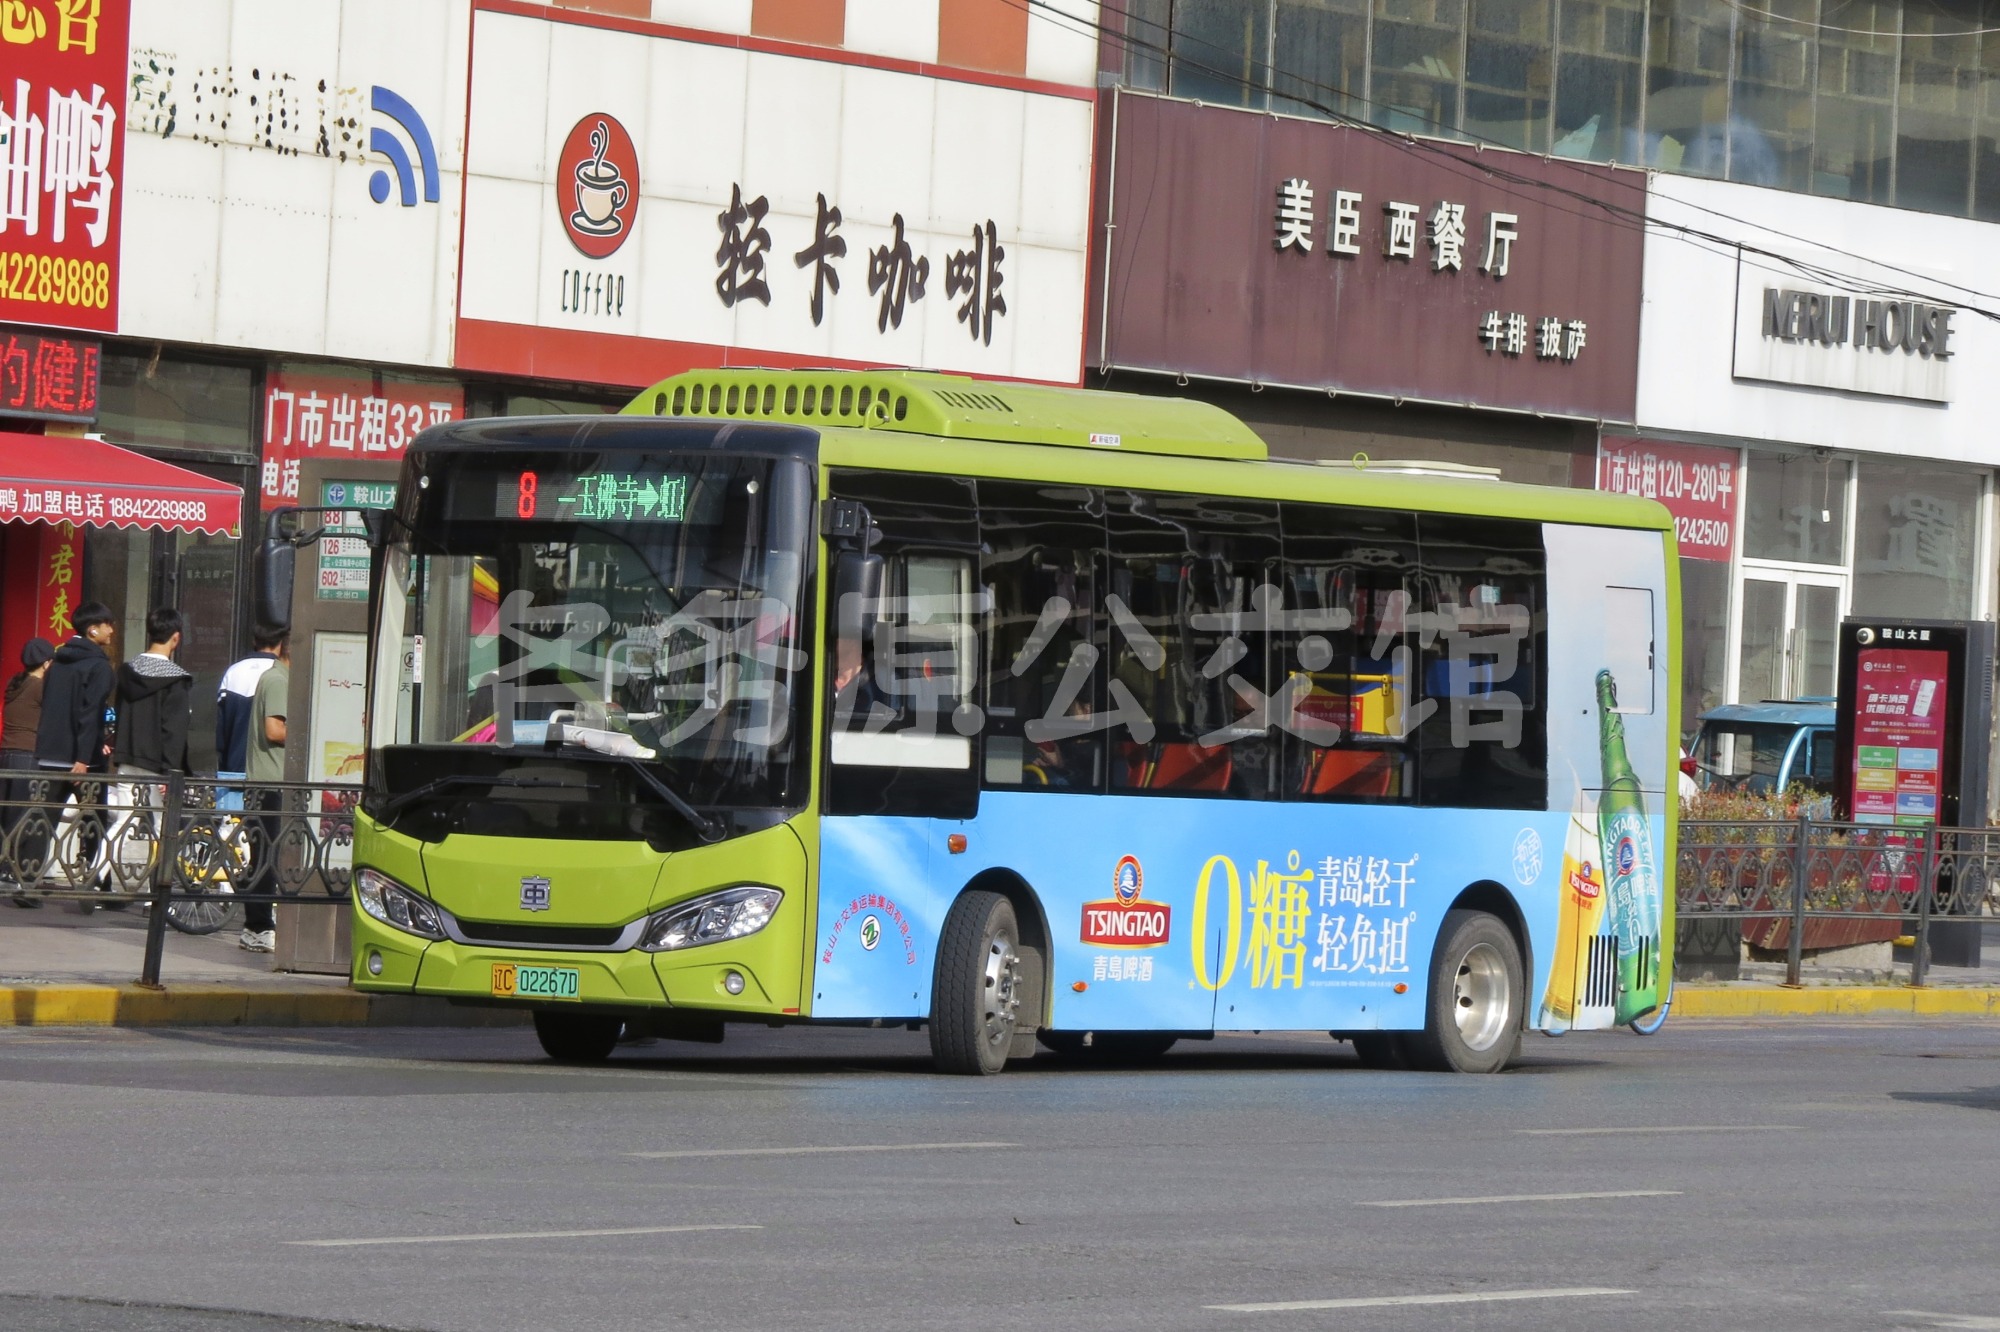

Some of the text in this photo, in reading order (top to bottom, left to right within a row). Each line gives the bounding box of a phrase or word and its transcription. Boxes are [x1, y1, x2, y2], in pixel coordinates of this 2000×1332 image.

[1274, 178, 1518, 277] 美臣西餐厅
[716, 183, 1007, 347] 轻卡咖啡
[1479, 311, 1586, 360] 牛排 披萨
[1853, 299, 1957, 357] HOUSE
[262, 457, 300, 498] 电话
[518, 472, 537, 519] 8
[23, 489, 104, 518] 加盟电话
[109, 497, 207, 522] 18842289888
[323, 540, 340, 555] 126
[321, 571, 338, 586] 602
[1881, 627, 1931, 641] 鞍山大厦
[328, 679, 366, 689] 仁心一
[1087, 910, 1166, 938] TSINGTAO
[1312, 911, 1417, 975] 轻负担
